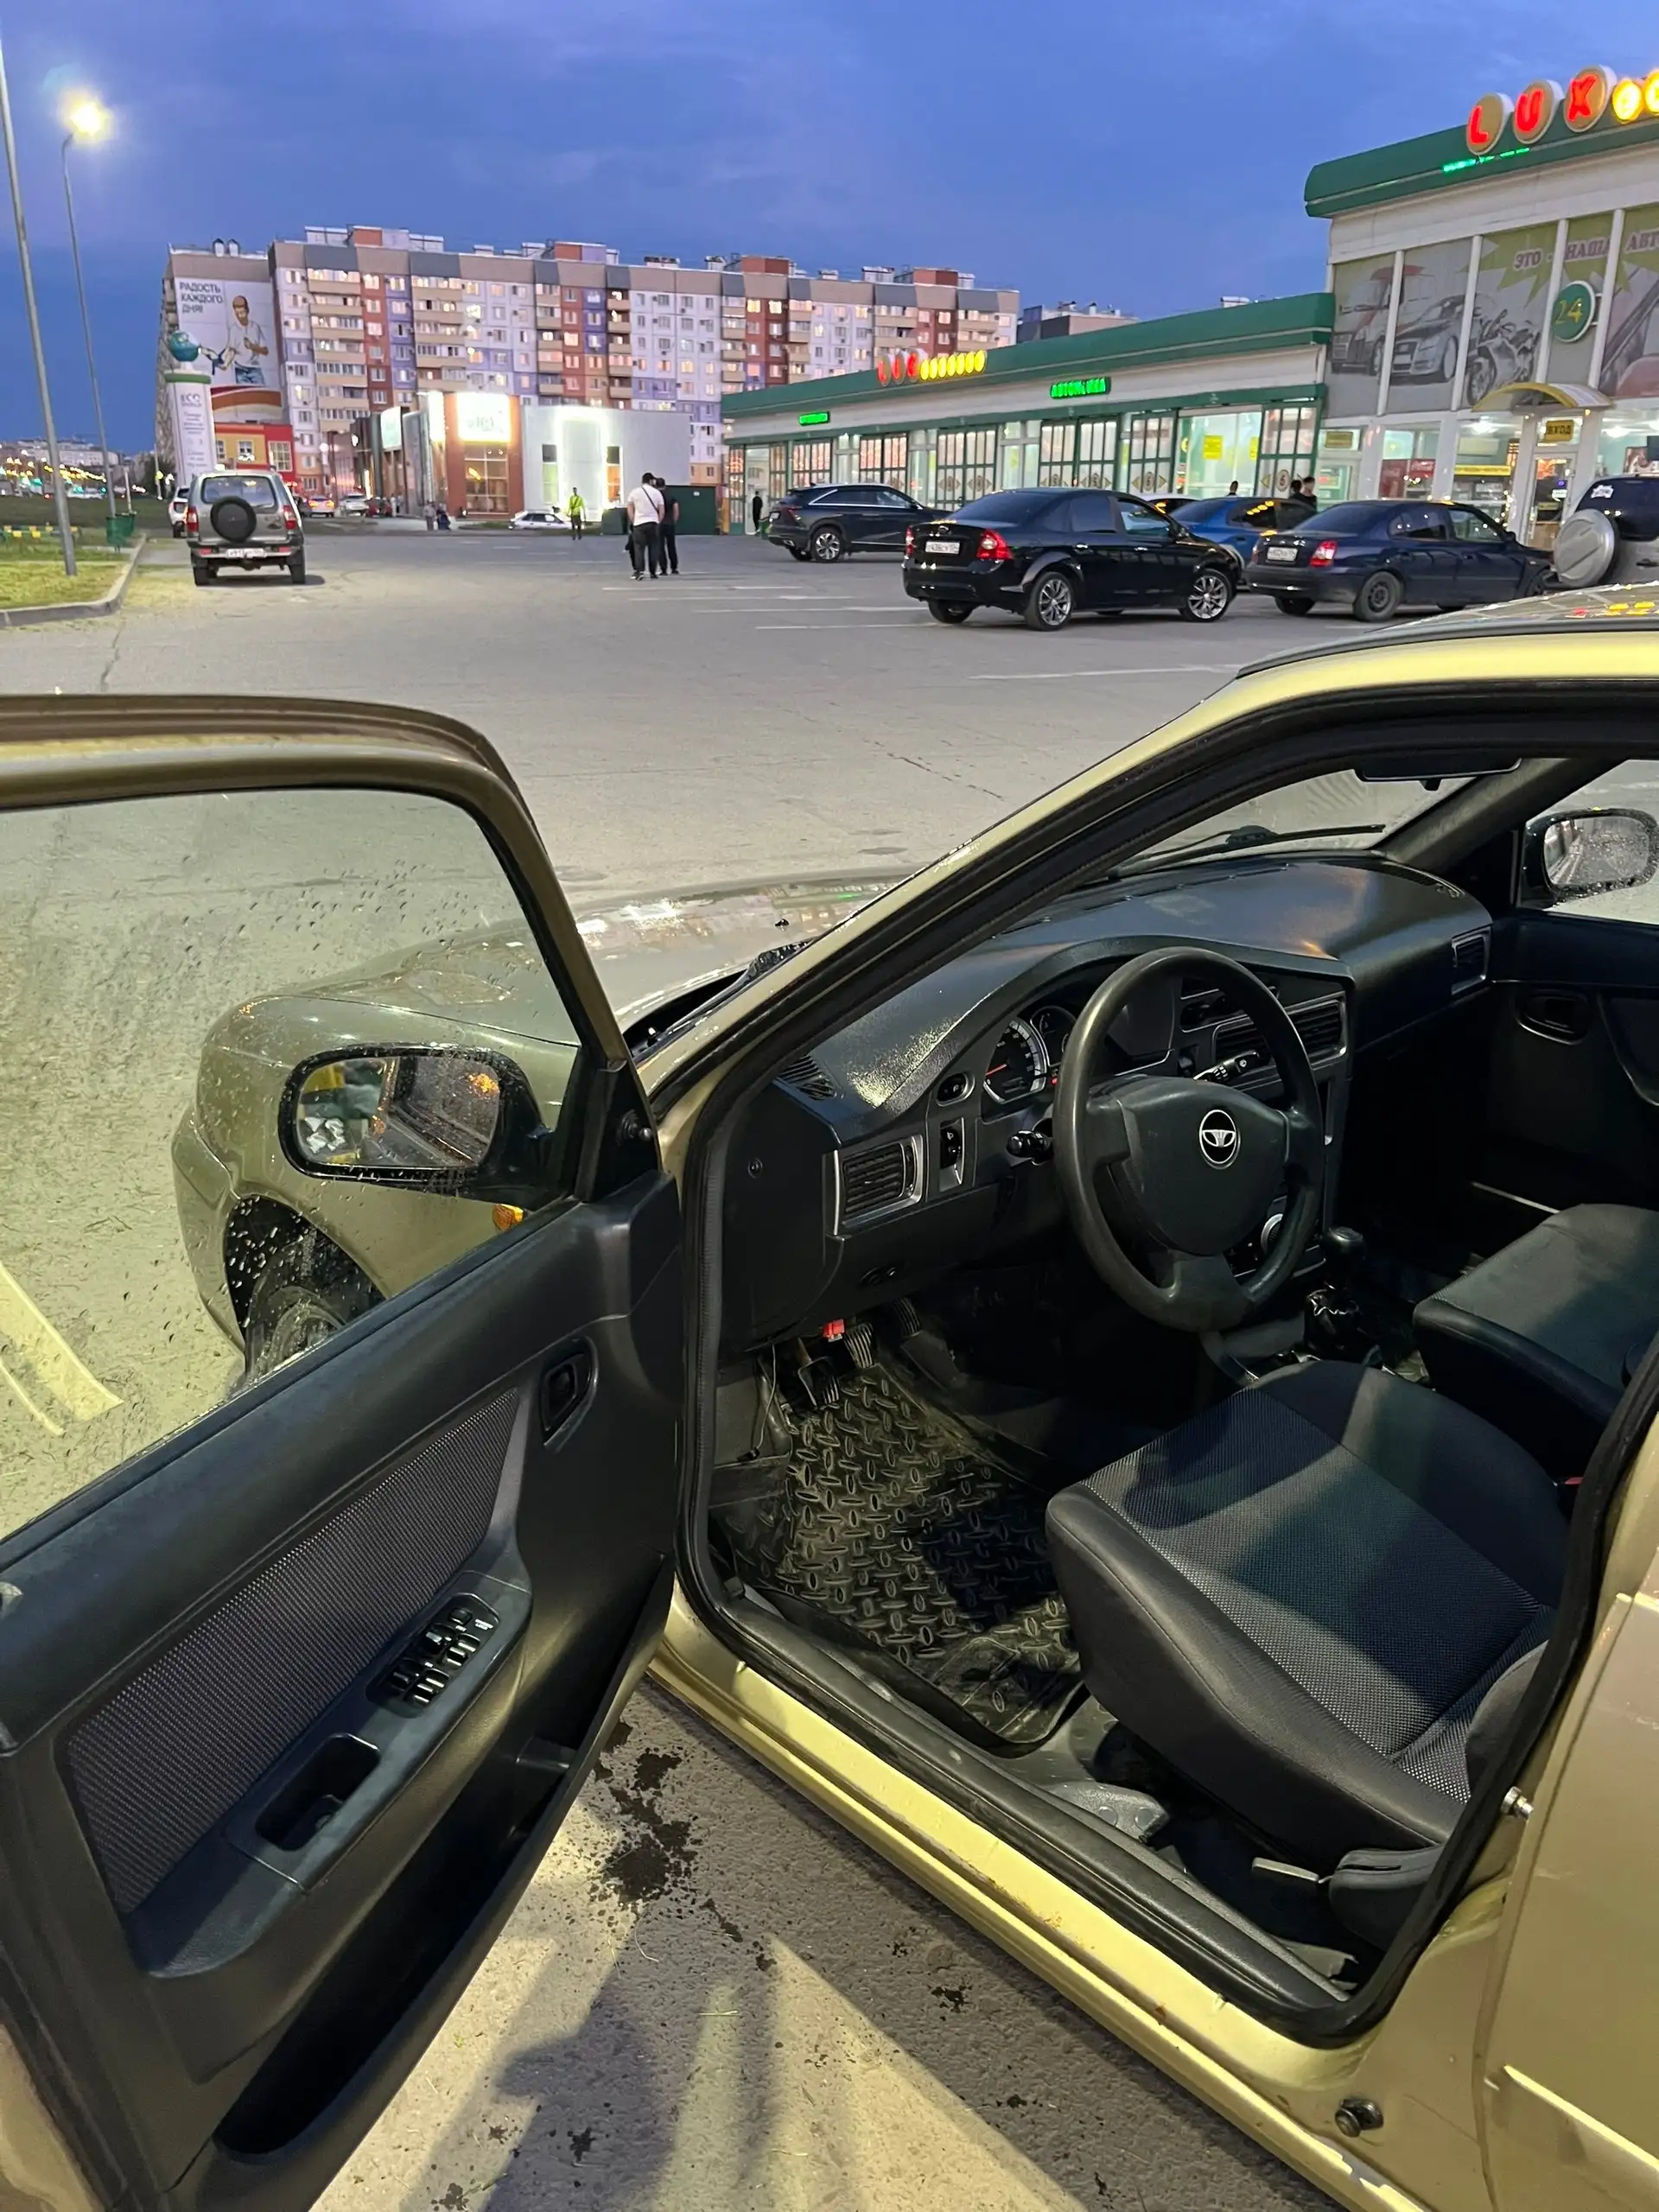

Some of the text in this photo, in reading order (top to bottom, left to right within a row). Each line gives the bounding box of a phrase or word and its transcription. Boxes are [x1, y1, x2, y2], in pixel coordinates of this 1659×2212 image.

[1470, 74, 1599, 144] LUX
[1515, 251, 1541, 269] ЭТО
[179, 282, 221, 293] РАДОСТЬ
[181, 293, 224, 303] КАЖДОГО
[1555, 298, 1583, 324] 24
